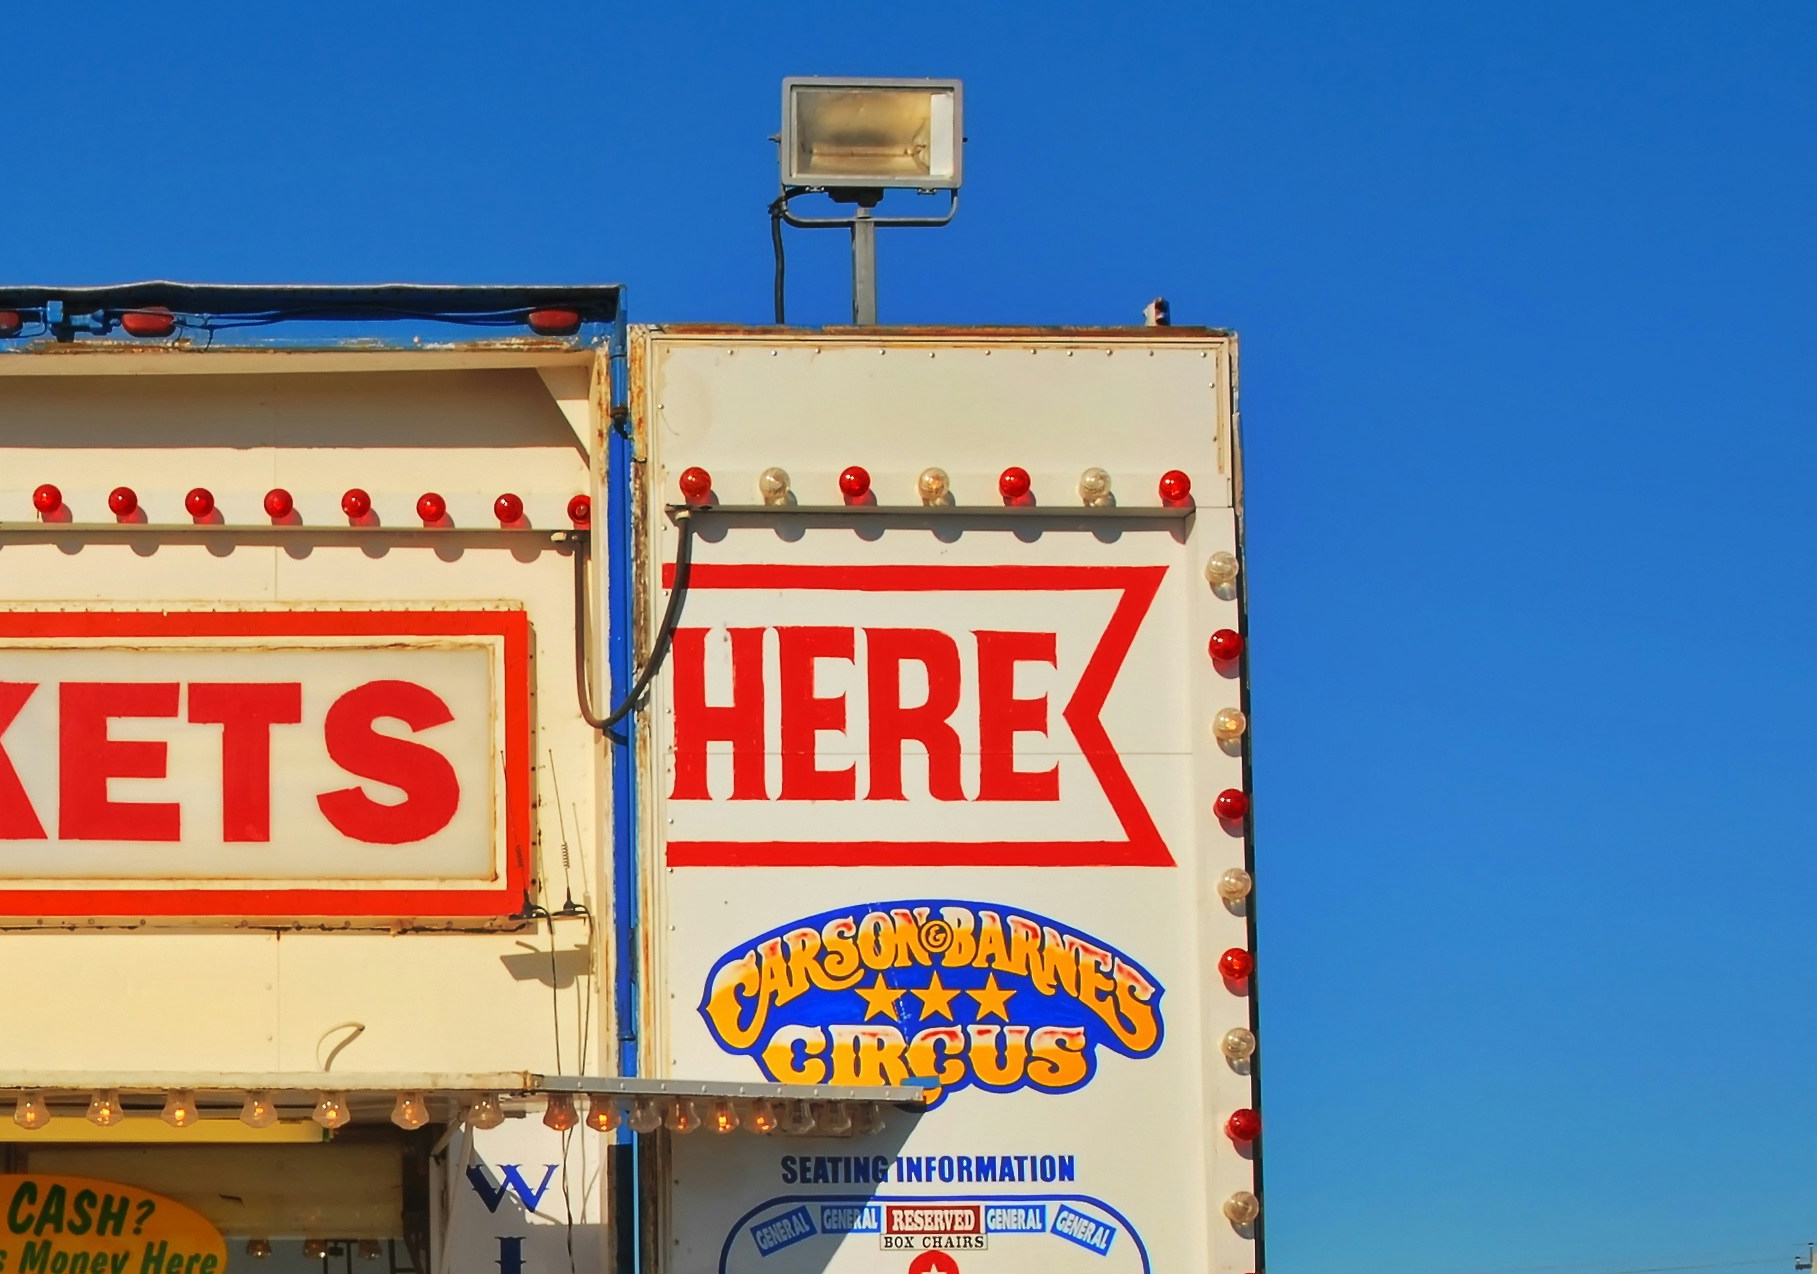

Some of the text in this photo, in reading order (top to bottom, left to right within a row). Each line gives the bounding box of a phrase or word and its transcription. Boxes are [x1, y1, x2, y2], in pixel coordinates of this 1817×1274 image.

[669, 626, 1060, 802] HERE
[706, 907, 1156, 1053] CARSON & BARNES
[762, 1024, 1087, 1104] CIRCUS
[781, 1155, 1075, 1183] SEATING INFORMATION
[7, 1181, 156, 1237] CASH?
[822, 1208, 878, 1231] GENERAL
[891, 1209, 976, 1231] RESERVED
[986, 1207, 1044, 1231] GENERAL
[754, 1211, 810, 1252] GENERAL
[883, 1235, 984, 1249] BOX CHAIRS
[1056, 1211, 1110, 1253] GENERAL
